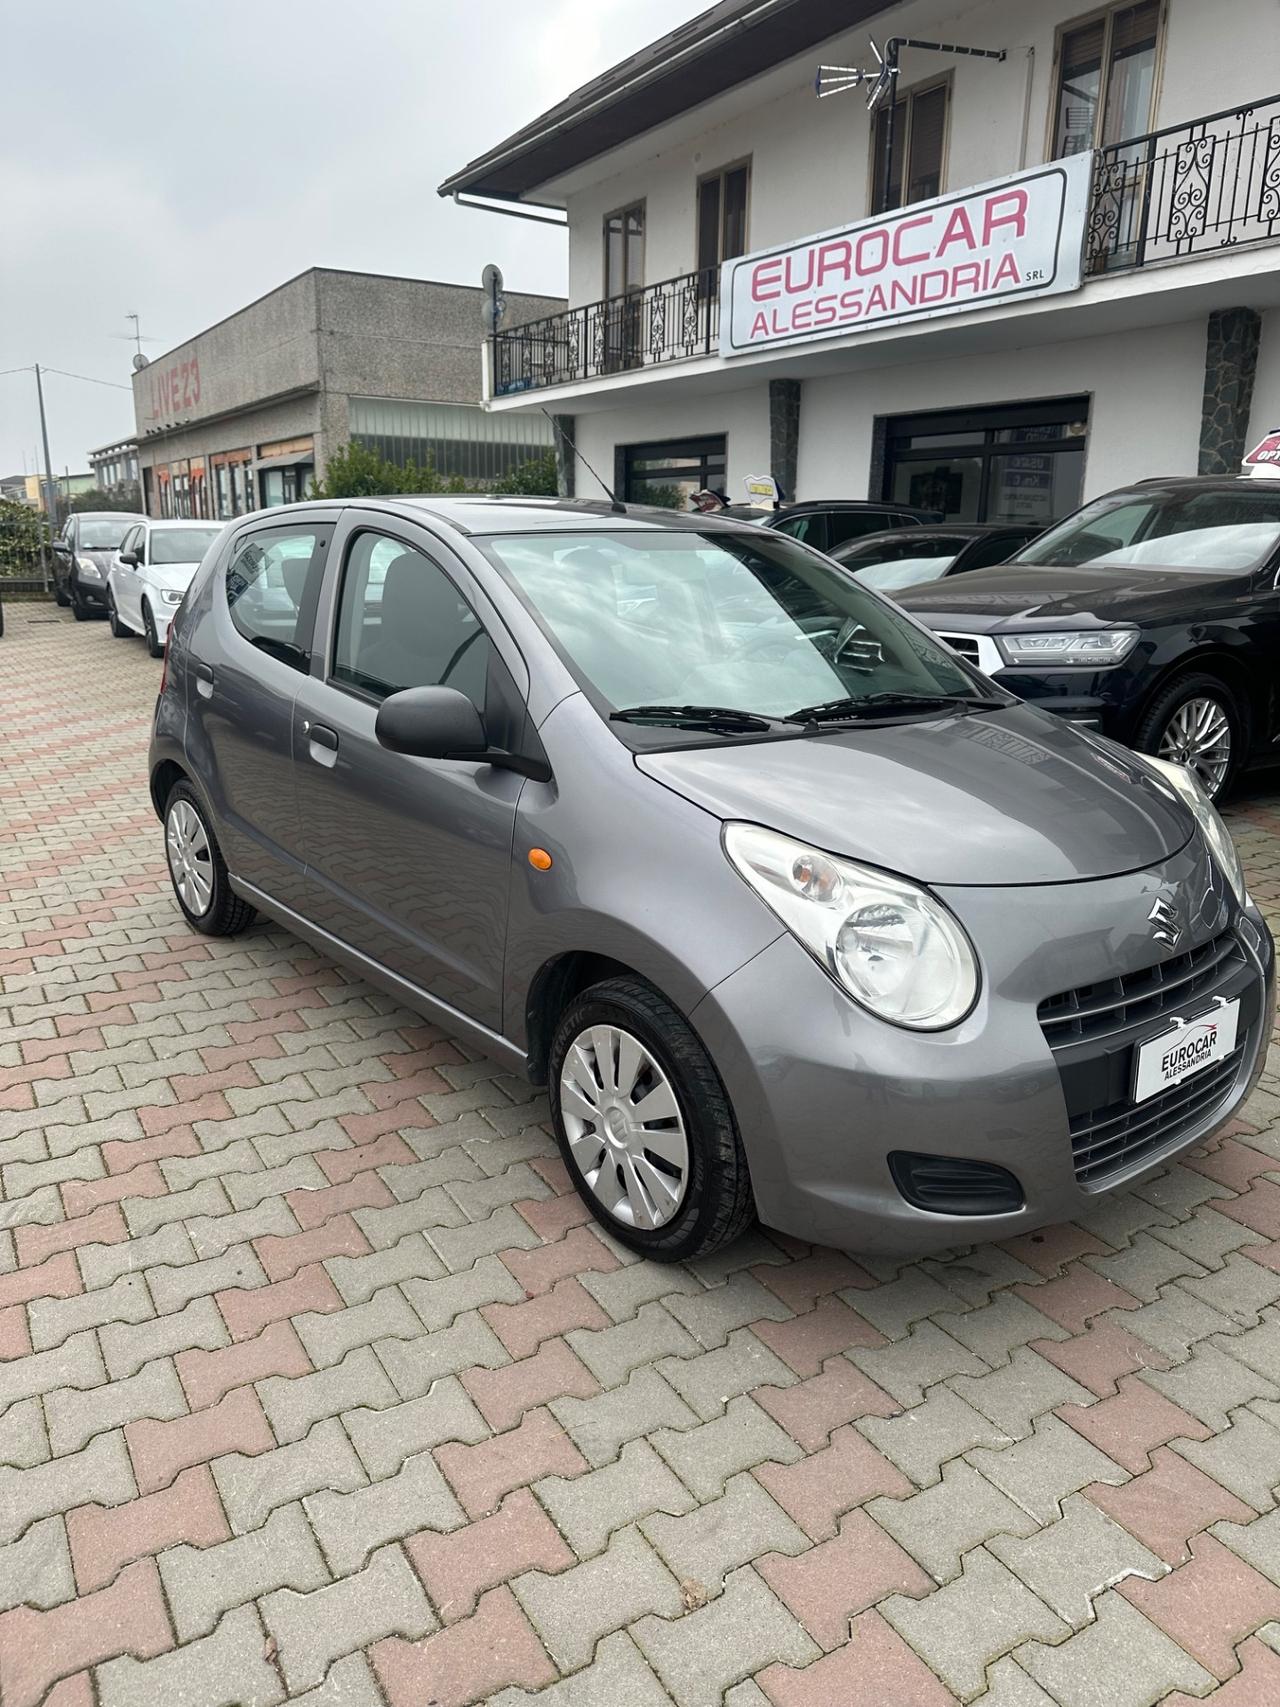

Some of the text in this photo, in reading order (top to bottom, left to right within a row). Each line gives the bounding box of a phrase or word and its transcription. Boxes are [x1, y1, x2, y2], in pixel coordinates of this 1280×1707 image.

[752, 188, 1028, 302] EUROCAR
[750, 252, 1044, 339] ALESSANDRIA SRL
[1257, 450, 1280, 460] OPT
[1161, 1031, 1217, 1072] EUROCAR
[1164, 1049, 1212, 1080] ALESSANDRIA
